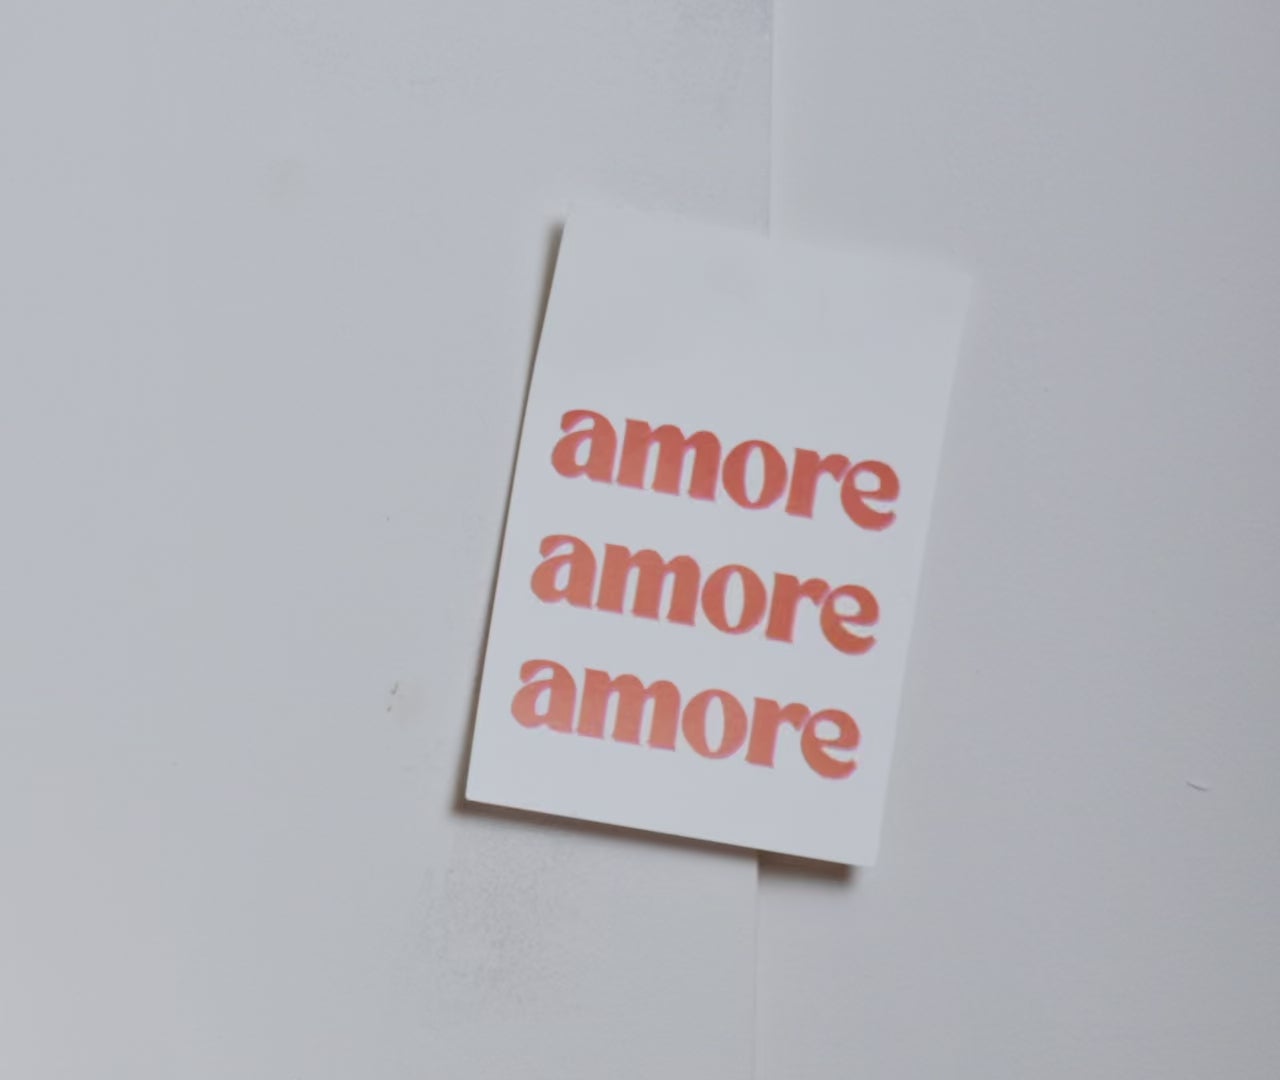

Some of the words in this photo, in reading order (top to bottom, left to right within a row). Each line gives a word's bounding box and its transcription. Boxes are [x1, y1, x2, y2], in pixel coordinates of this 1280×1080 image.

[550, 408, 901, 531] amore
[530, 533, 880, 655] amore
[510, 658, 861, 780] amore
